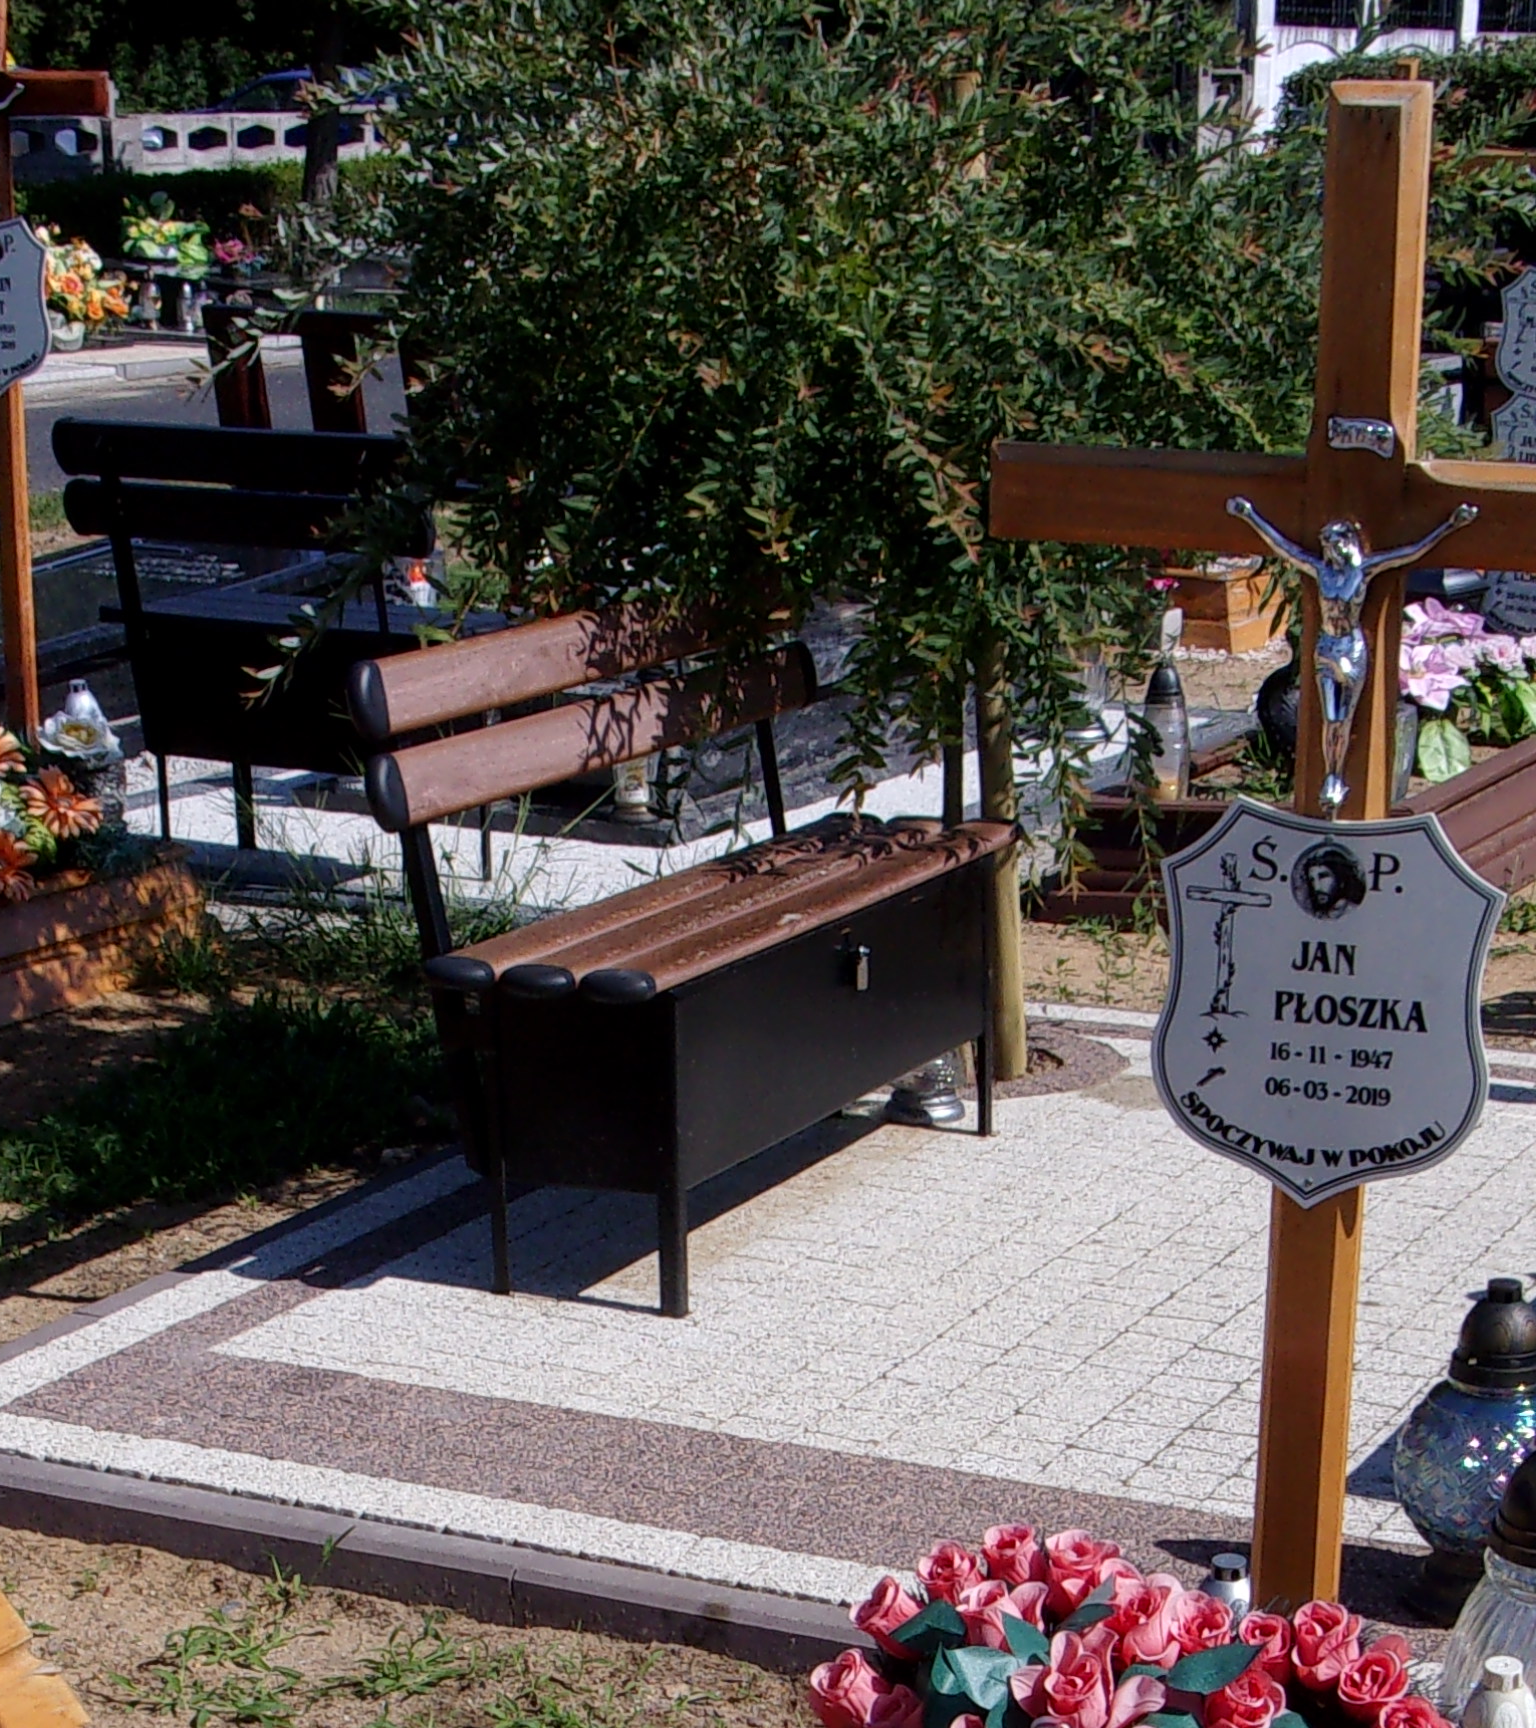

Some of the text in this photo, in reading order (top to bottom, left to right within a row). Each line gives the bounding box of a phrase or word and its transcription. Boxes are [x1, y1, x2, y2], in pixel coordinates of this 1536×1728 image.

[1248, 835, 1404, 894] Ś. P.
[1291, 940, 1357, 976] JAN
[1273, 989, 1428, 1033] PŁOSZKA
[1180, 1090, 1447, 1168] SPOCZYWAJ W POKOJU
